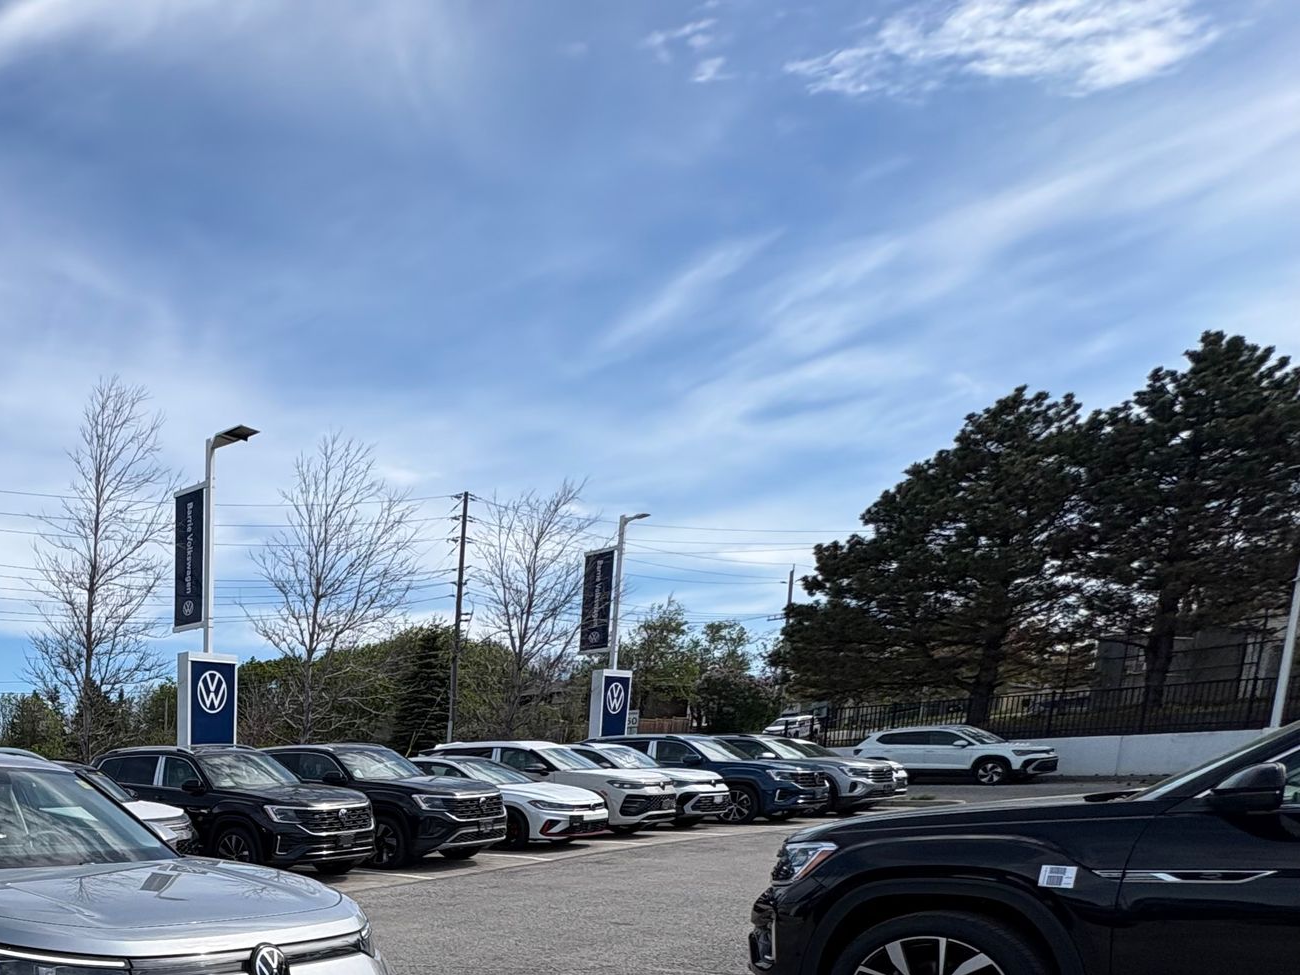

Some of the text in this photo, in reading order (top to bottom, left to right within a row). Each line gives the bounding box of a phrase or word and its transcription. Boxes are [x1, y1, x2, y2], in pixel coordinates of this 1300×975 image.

[185, 502, 194, 594] Barrie Volkswagen
[197, 670, 227, 714] VW
[607, 682, 625, 715] VW
